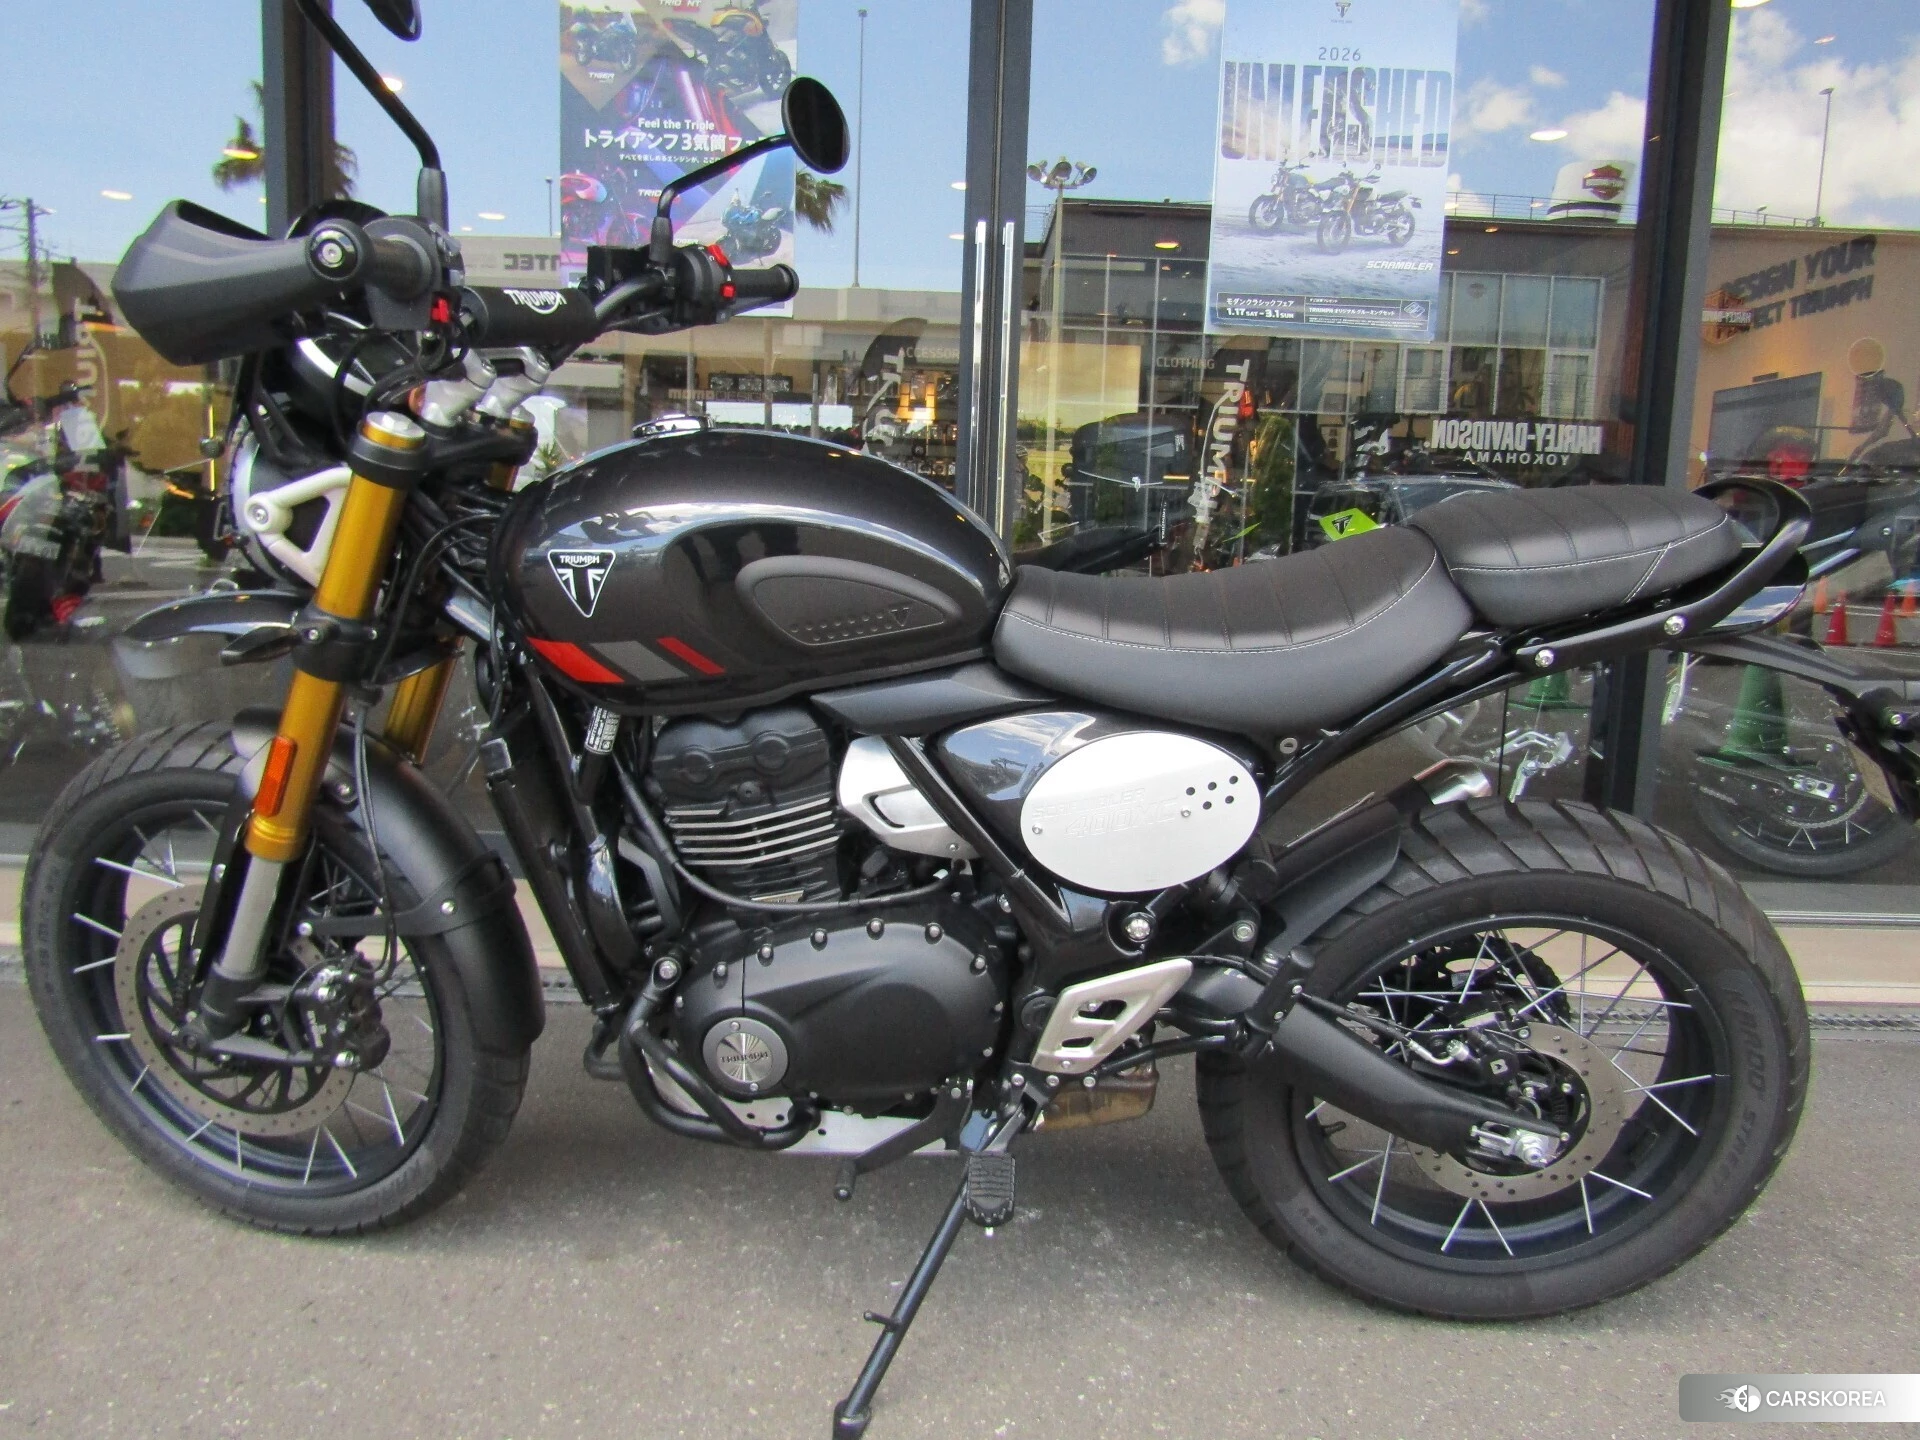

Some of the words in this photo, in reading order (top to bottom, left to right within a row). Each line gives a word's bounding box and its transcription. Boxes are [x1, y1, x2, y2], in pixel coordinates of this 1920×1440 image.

[1318, 46, 1361, 61] 2026
[1221, 61, 1453, 168] UNLEASHED
[638, 118, 660, 128] Feel
[663, 120, 681, 129] the
[685, 120, 715, 131] Triple
[1804, 234, 1878, 282] YOUR
[1366, 260, 1433, 271] SCRAMBLER
[503, 289, 567, 315] TRIUMPH
[1226, 297, 1295, 308] モダンクラシックフェア
[1156, 356, 1216, 370] CLOTHING
[559, 555, 600, 568] TRIUMPH
[721, 1051, 769, 1064] TRIUMPH
